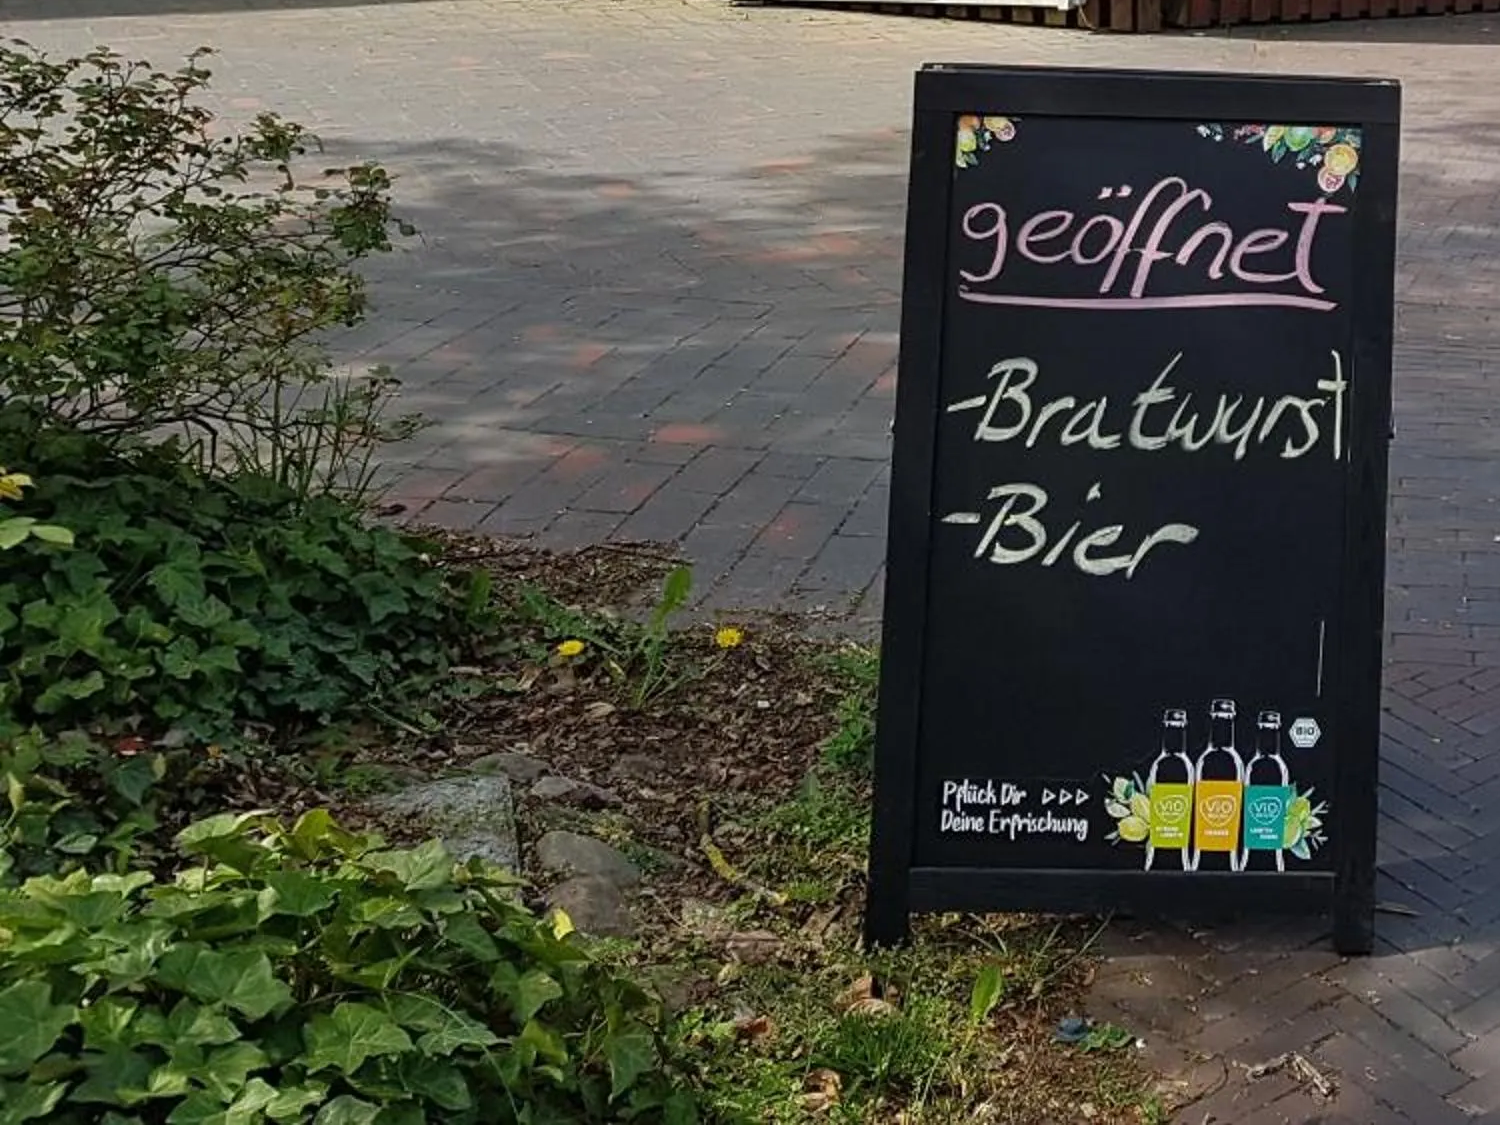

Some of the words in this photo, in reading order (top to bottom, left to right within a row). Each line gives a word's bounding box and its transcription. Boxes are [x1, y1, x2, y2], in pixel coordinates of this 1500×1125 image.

[959, 176, 1347, 300] geöffnet
[943, 778, 997, 812] Pflück
[1001, 782, 1027, 806] Dir
[940, 809, 985, 832] Deine
[988, 809, 1088, 841] Erfrischung
